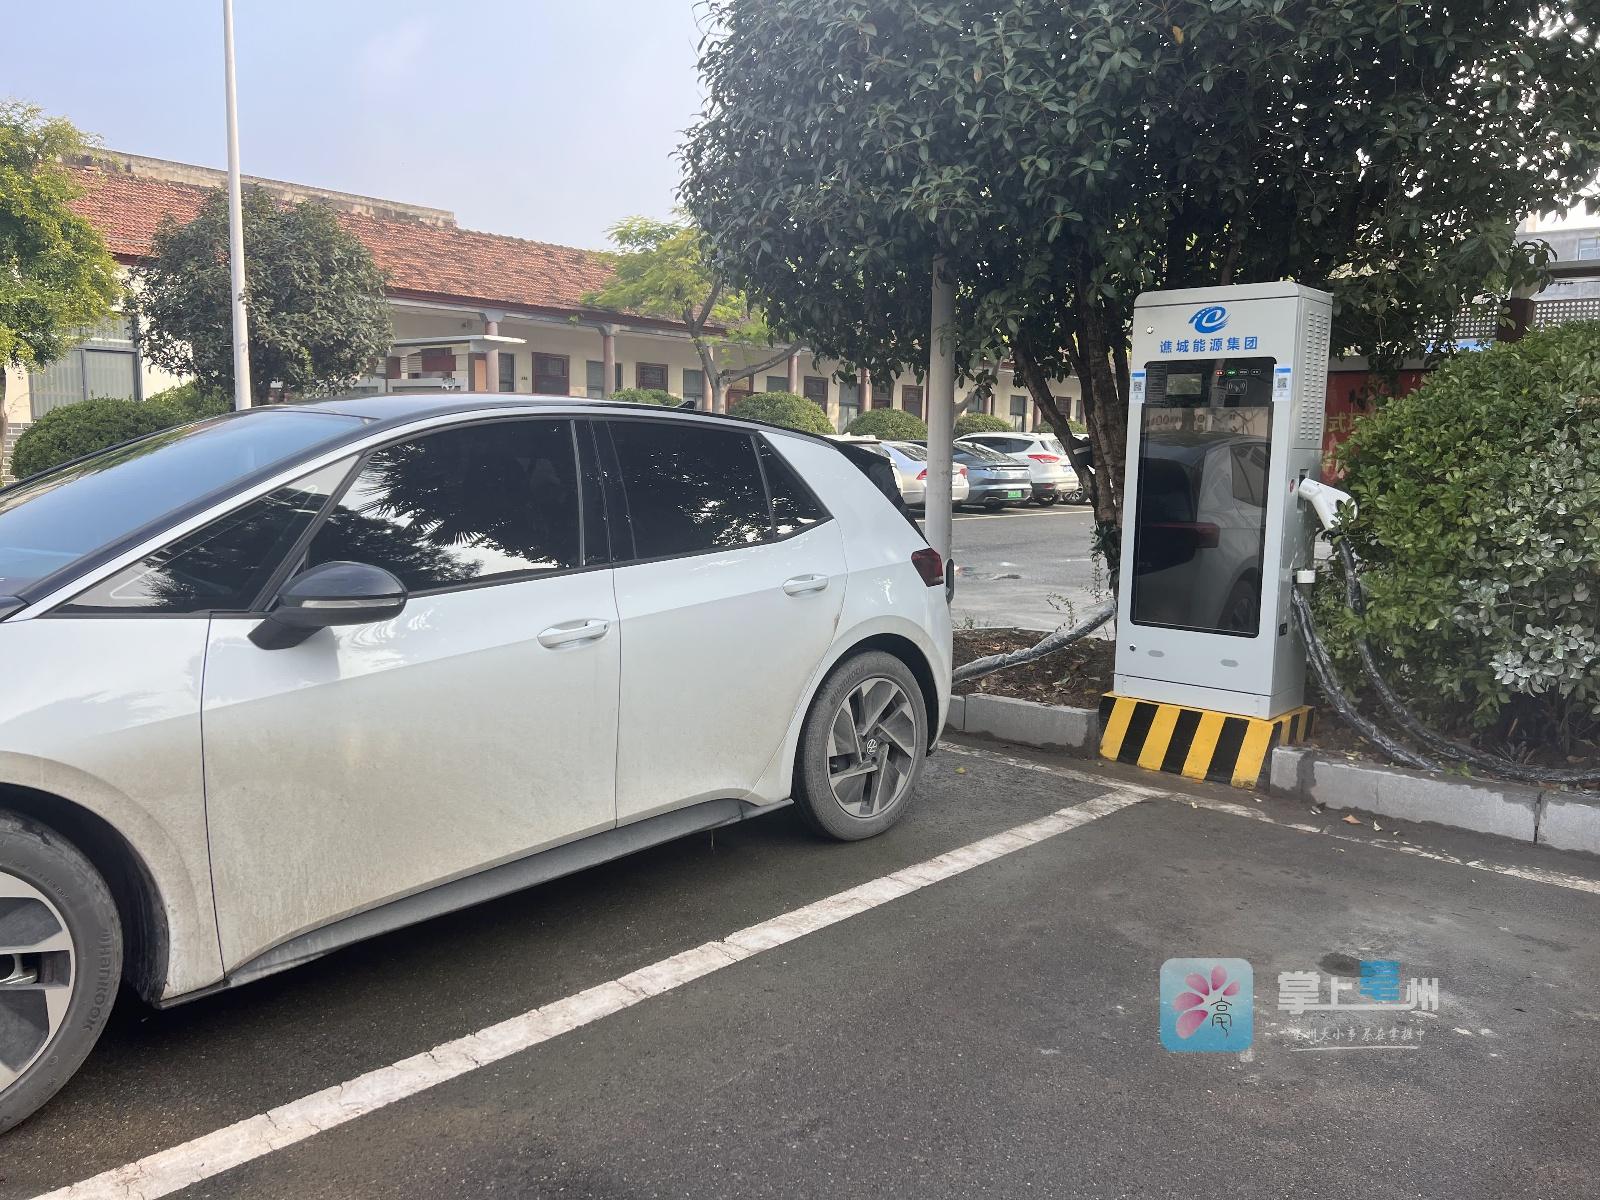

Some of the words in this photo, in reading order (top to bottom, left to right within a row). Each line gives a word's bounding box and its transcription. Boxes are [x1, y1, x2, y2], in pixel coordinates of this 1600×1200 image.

[1160, 337, 1257, 354] 谯城能源集团
